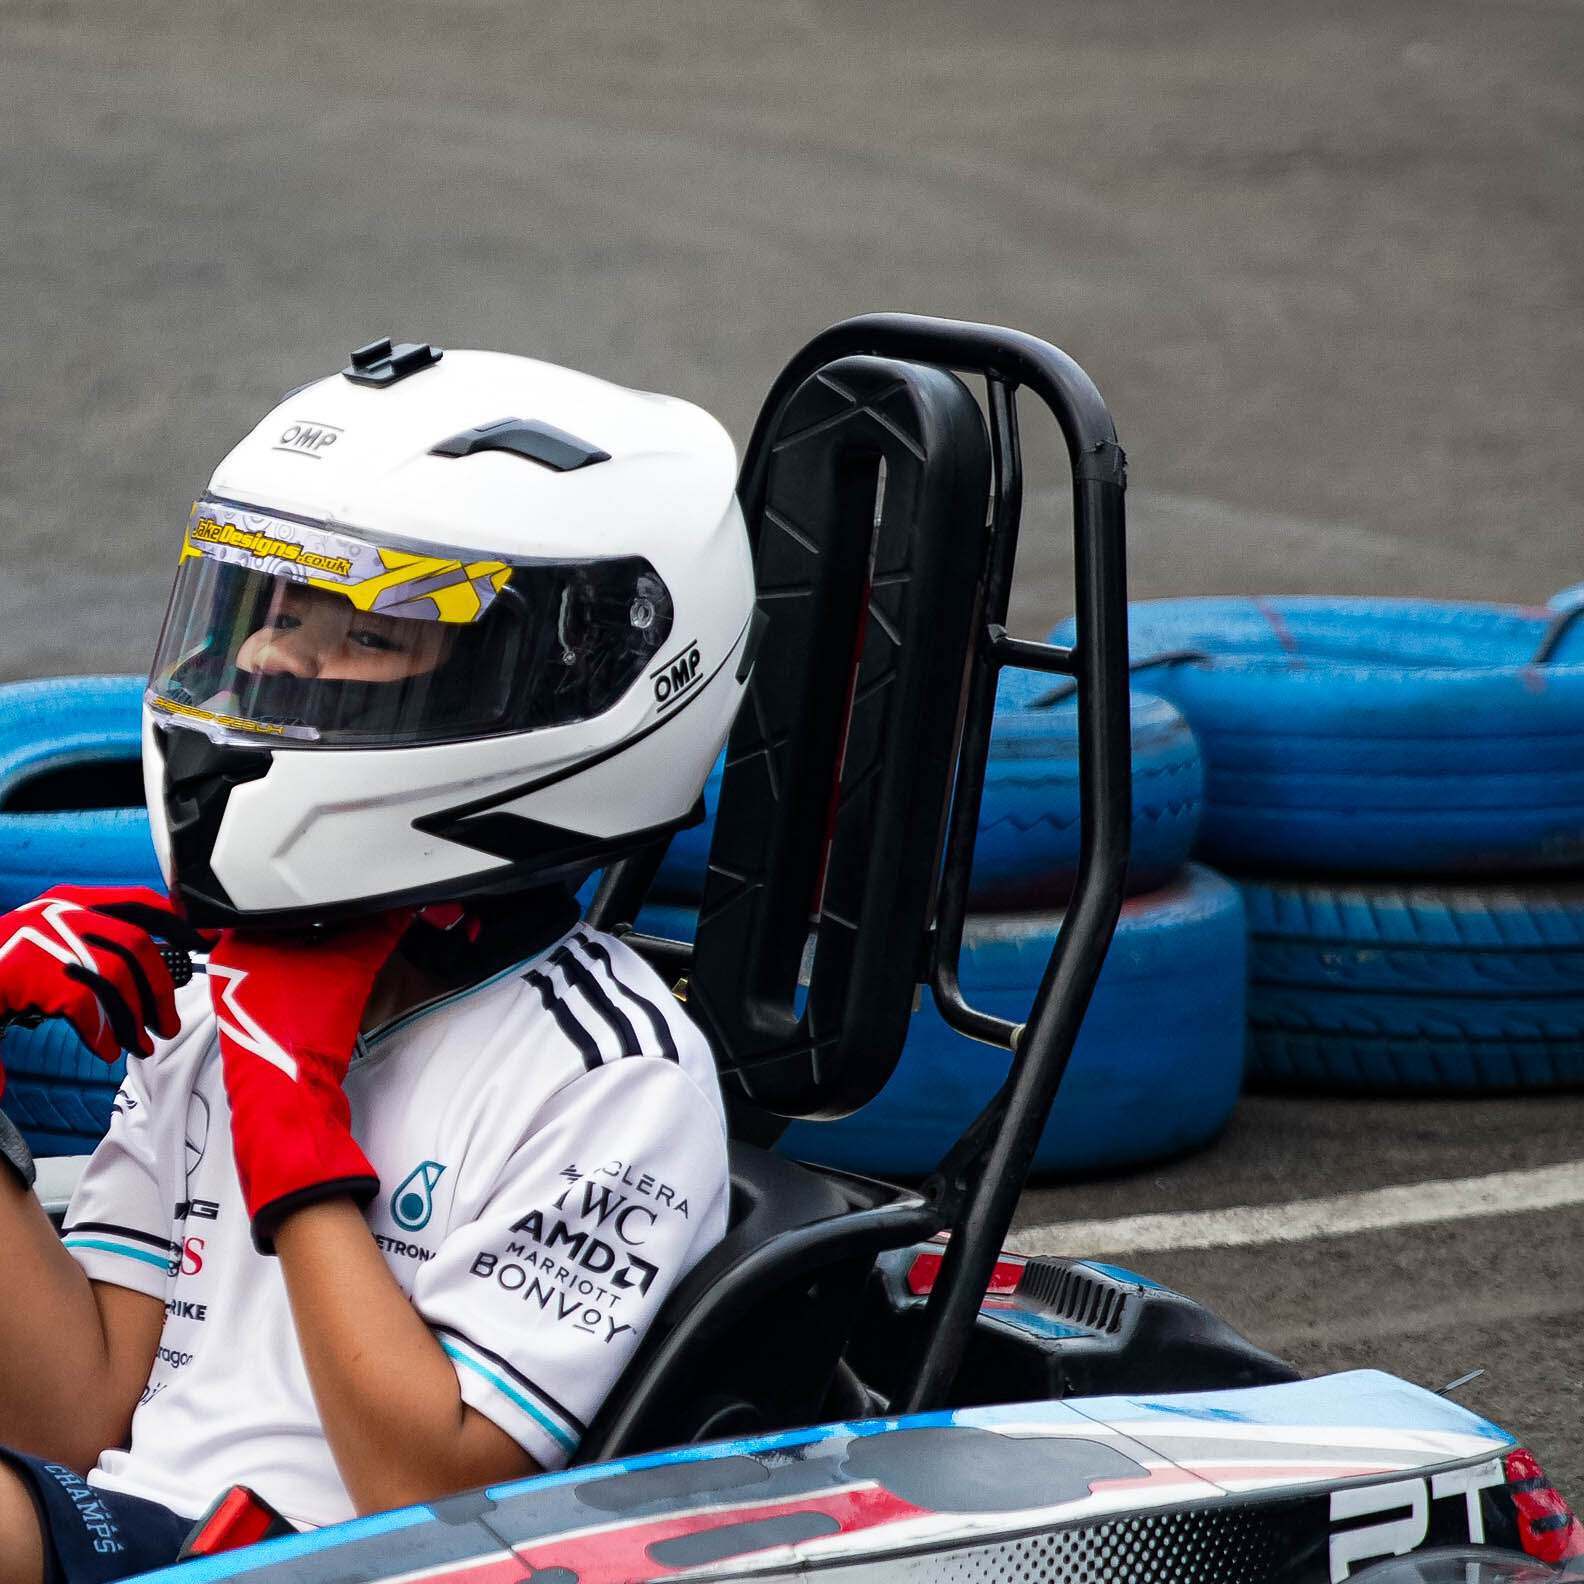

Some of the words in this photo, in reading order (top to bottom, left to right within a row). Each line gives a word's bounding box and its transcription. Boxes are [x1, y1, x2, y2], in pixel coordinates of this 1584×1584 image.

[279, 423, 338, 451] OMP
[654, 647, 701, 703] OMP
[552, 1179, 659, 1246] IWC
[594, 1160, 689, 1220] OLERA
[505, 1241, 622, 1308] MARRIOTT
[508, 1209, 616, 1274] AMD
[469, 1252, 633, 1345] BONVOY
[43, 1464, 117, 1553] CHAMPS
